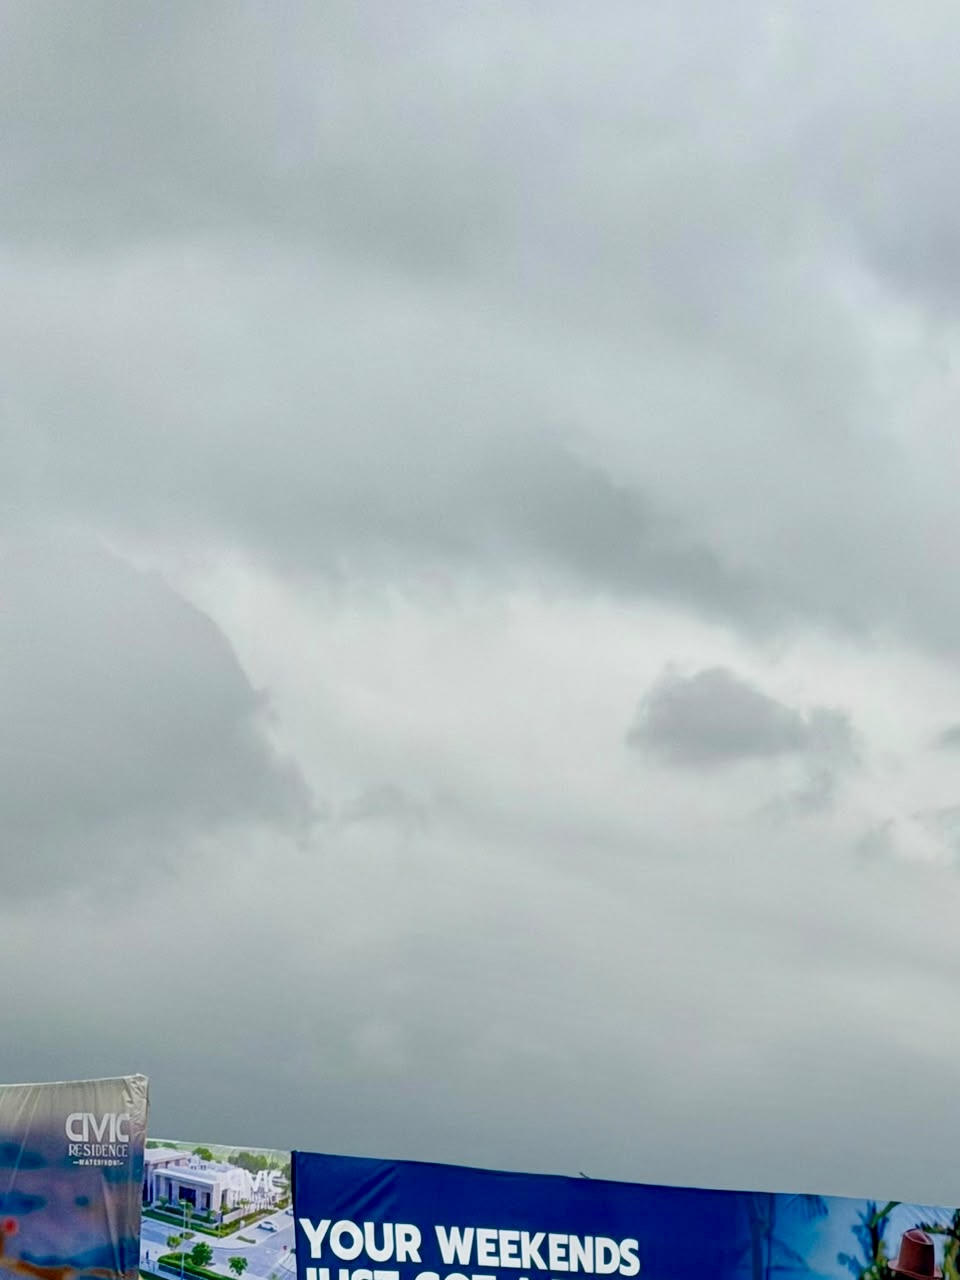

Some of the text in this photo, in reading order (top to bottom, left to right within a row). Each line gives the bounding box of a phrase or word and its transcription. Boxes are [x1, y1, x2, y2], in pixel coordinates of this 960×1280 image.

[65, 1112, 130, 1142] CIVIC
[68, 1144, 128, 1158] RESIDENCE
[299, 1218, 640, 1276] YOUR WEEKENDS
